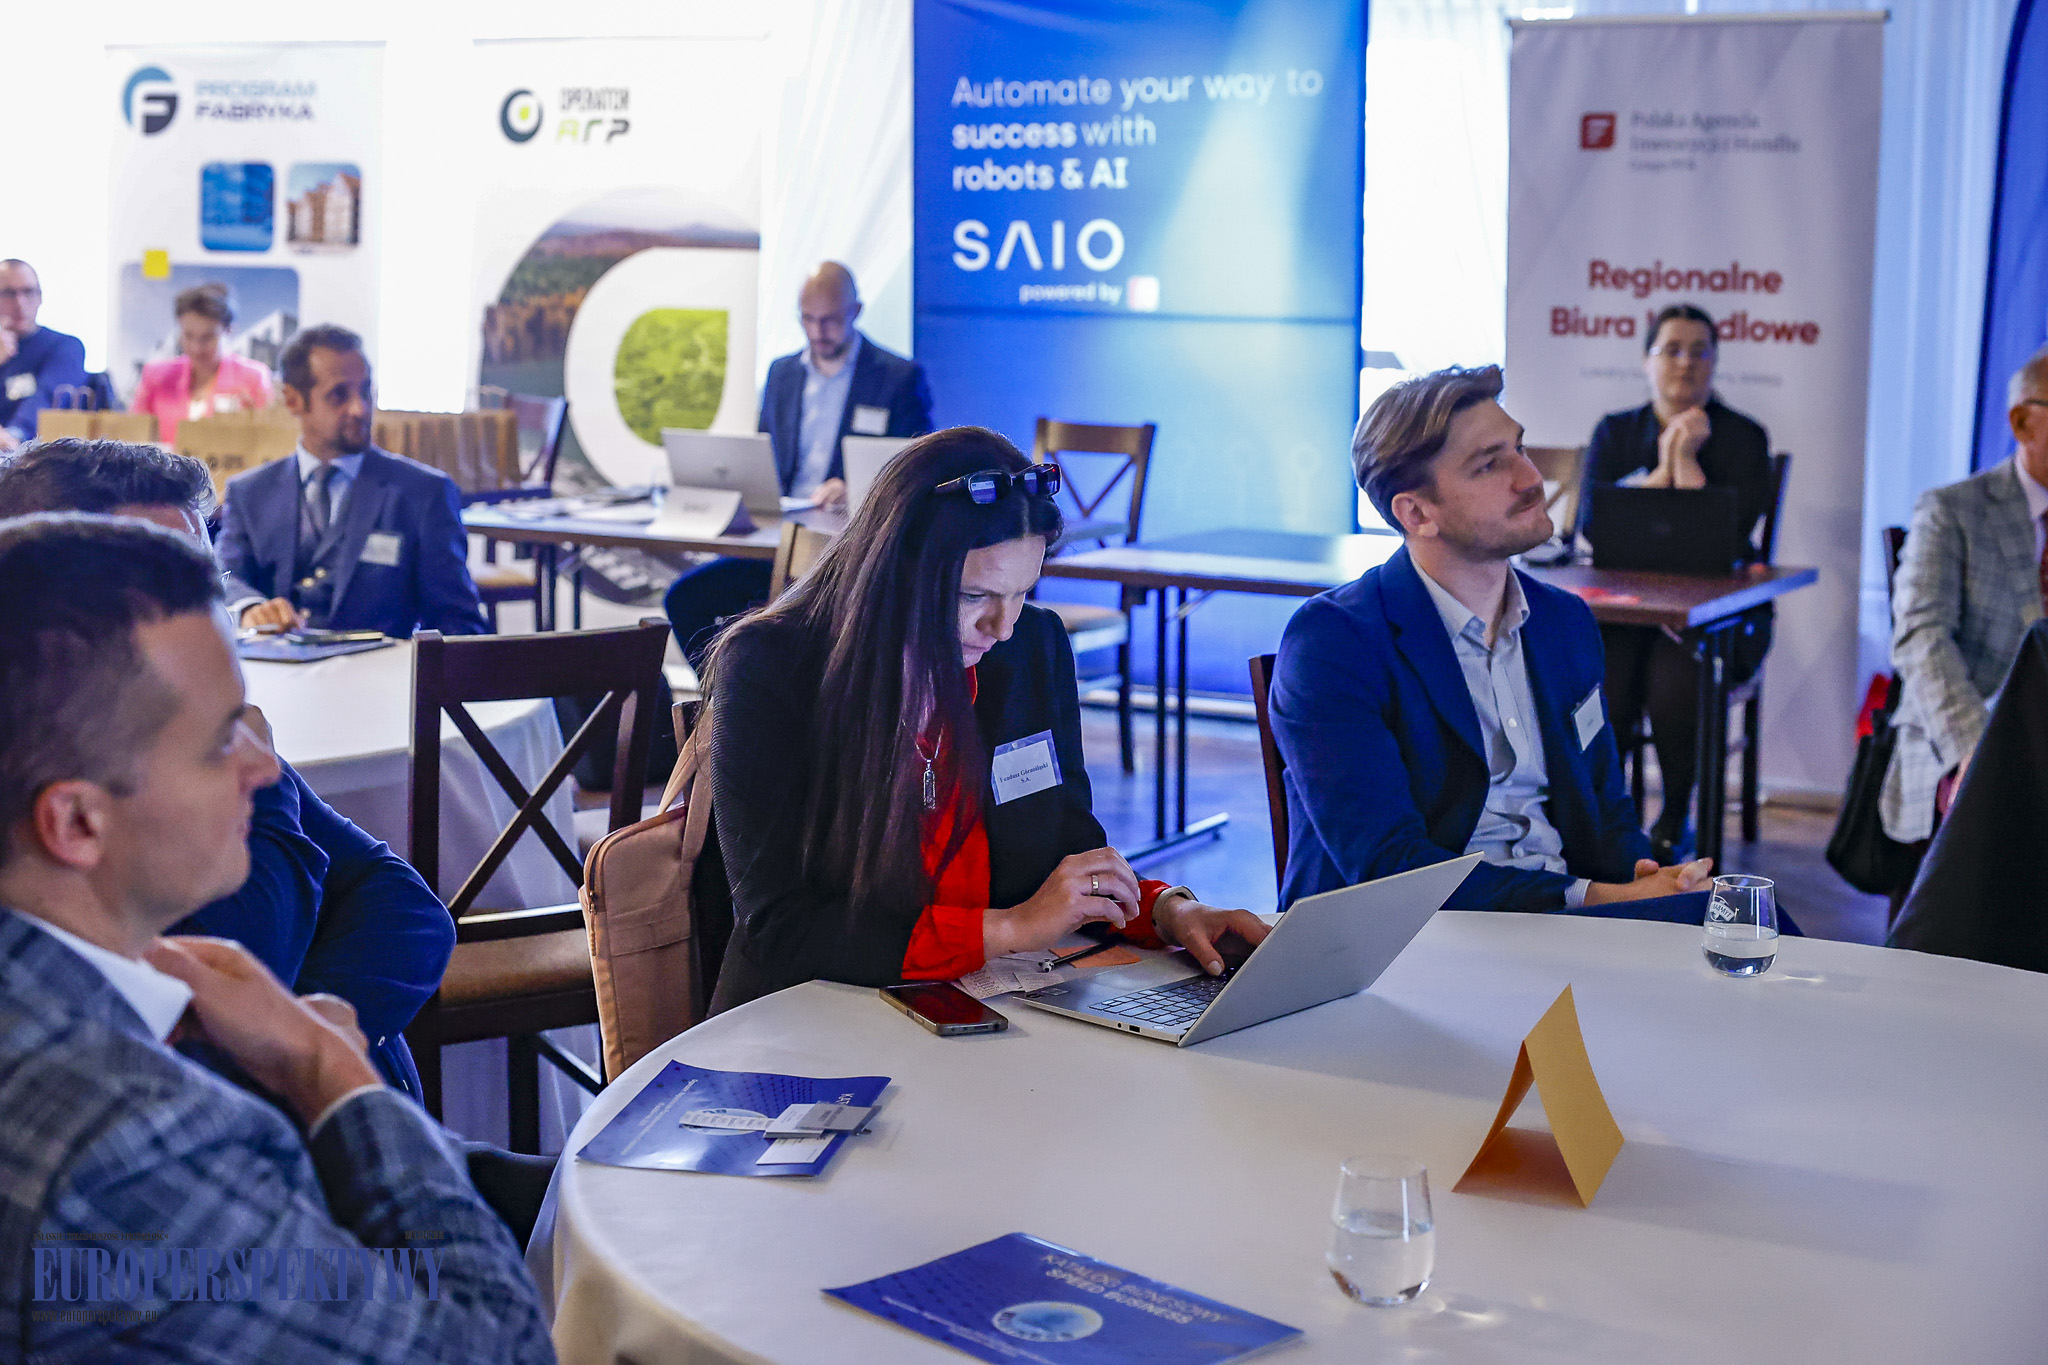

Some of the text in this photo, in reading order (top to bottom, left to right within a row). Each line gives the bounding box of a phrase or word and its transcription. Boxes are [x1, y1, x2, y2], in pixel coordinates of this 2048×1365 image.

[952, 69, 1324, 112] Automate your way to
[196, 104, 313, 119] FABRYKA
[952, 113, 1157, 149] success with
[952, 157, 1129, 191] robots & AI
[952, 219, 1125, 272] SAIO
[1018, 281, 1123, 305] powered by
[1588, 259, 1783, 299] Regionalne
[1551, 307, 1635, 337] Biura
